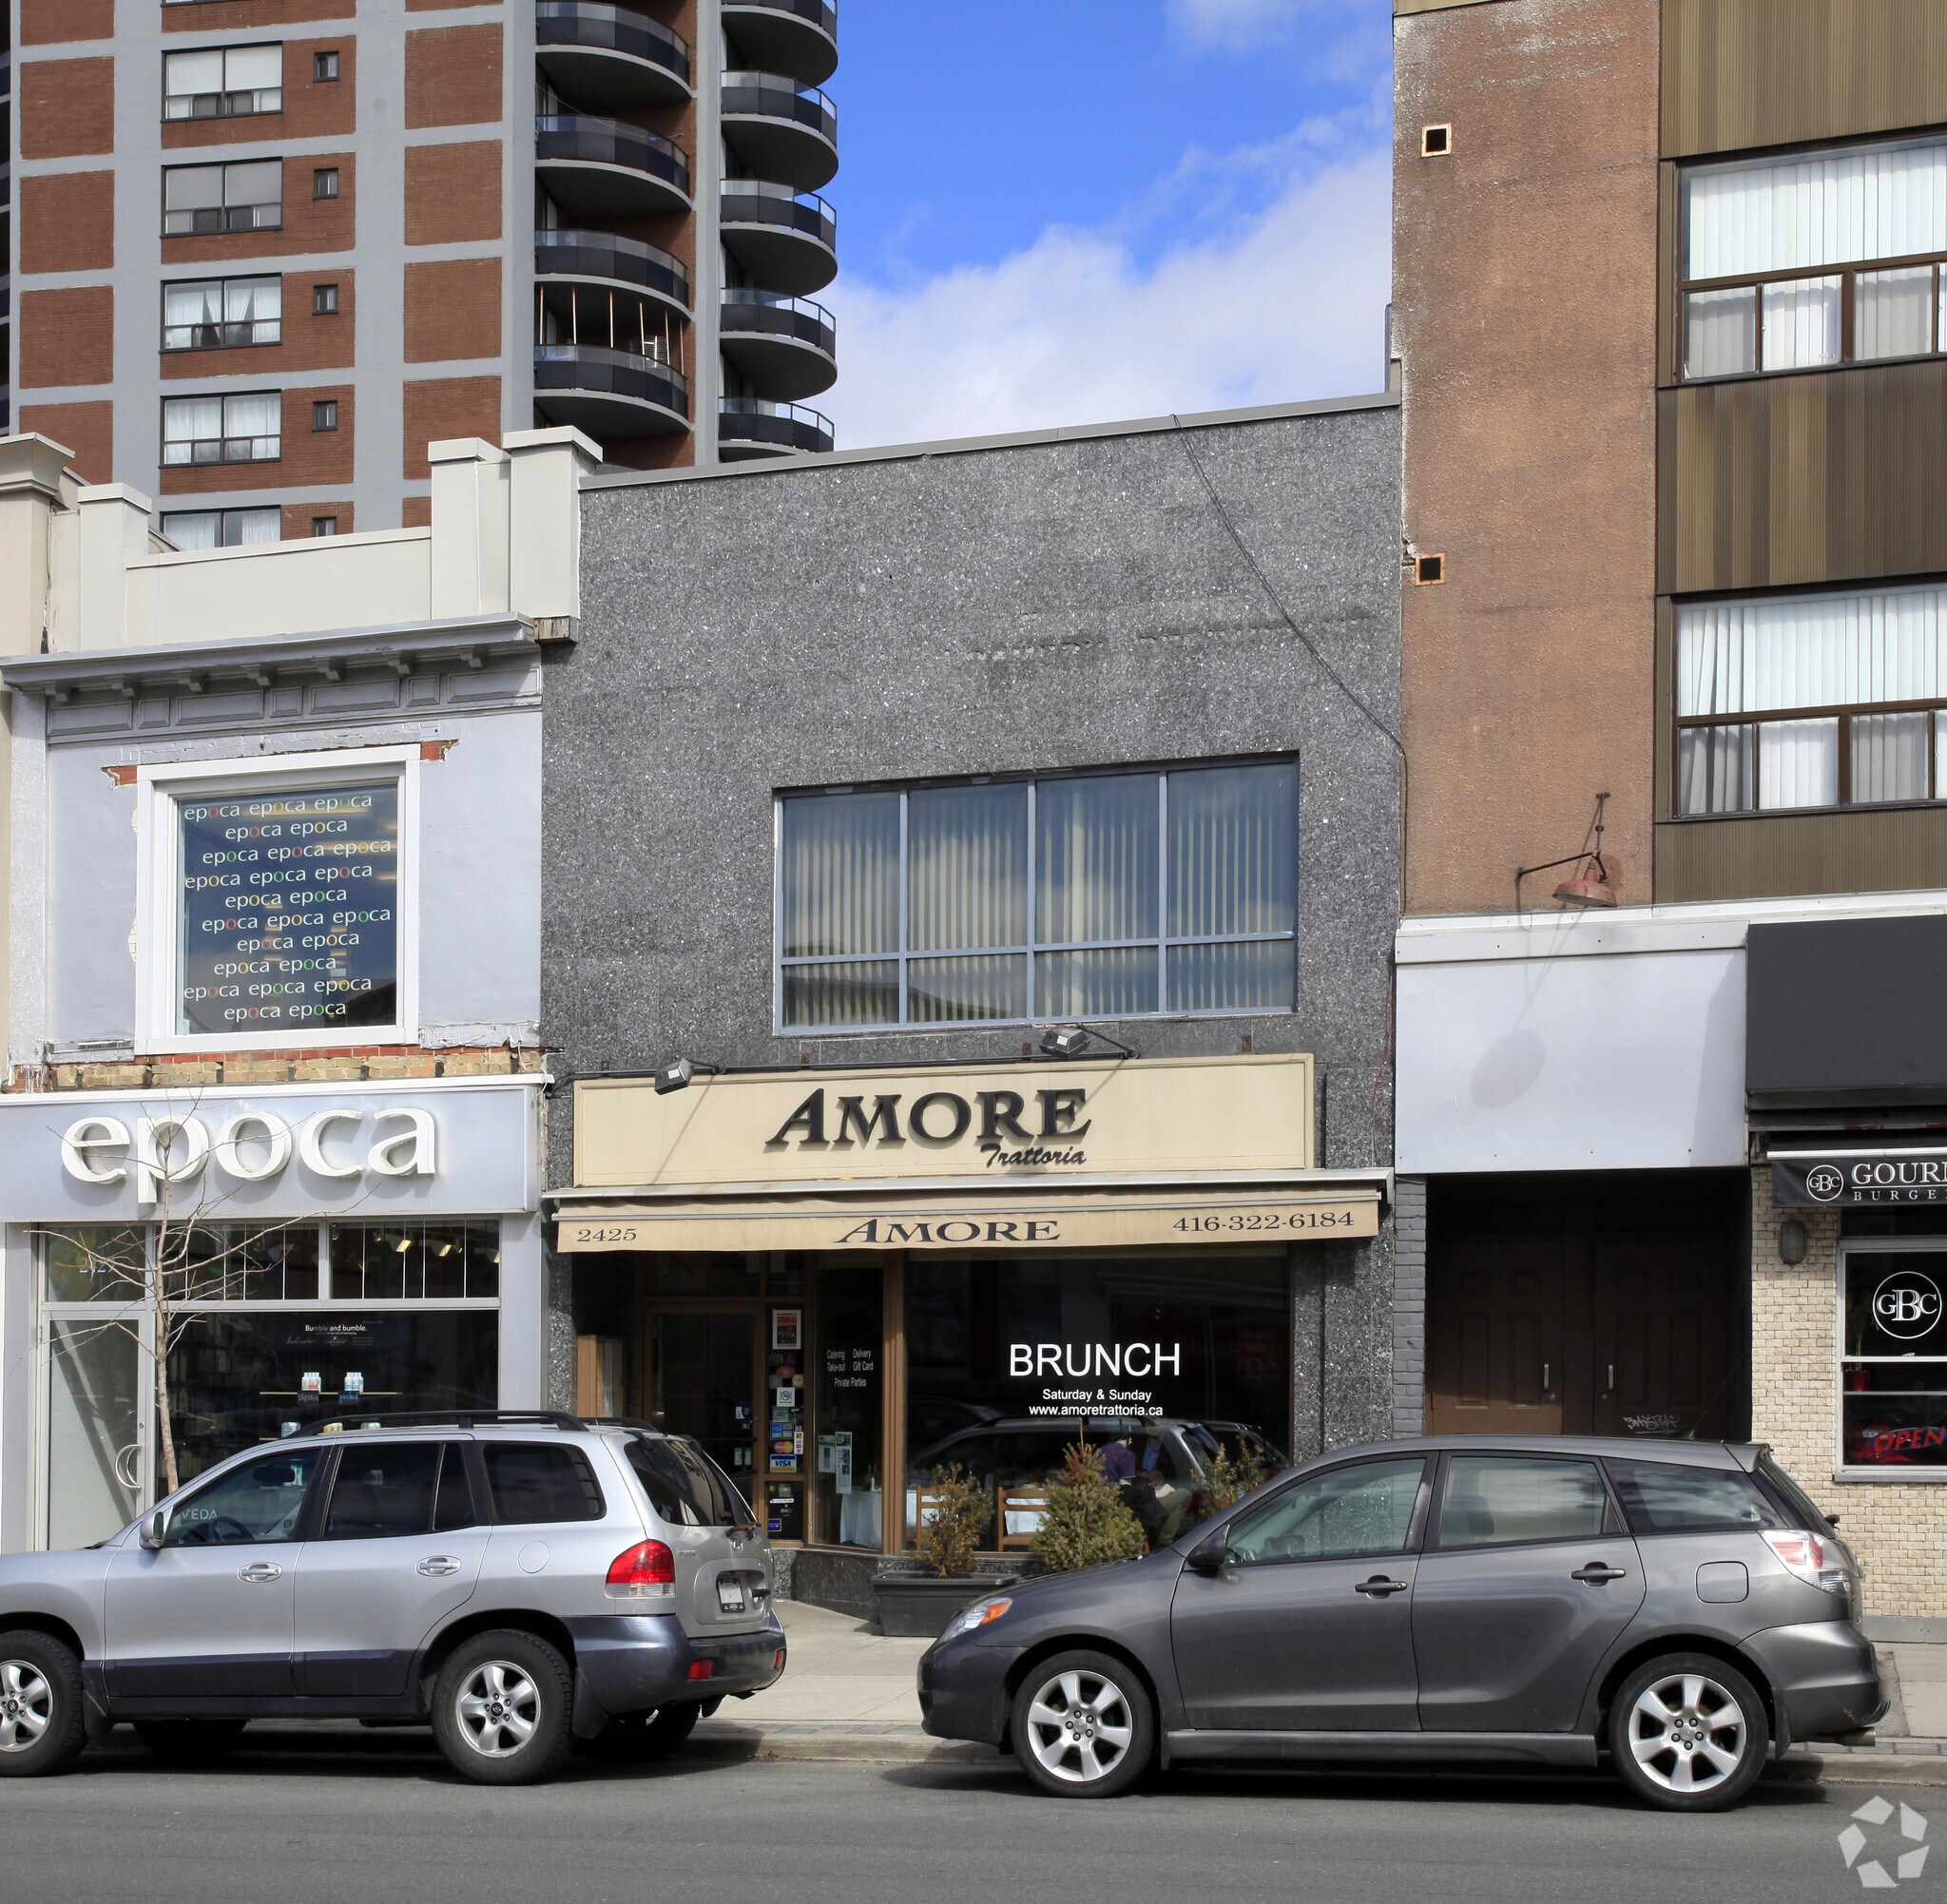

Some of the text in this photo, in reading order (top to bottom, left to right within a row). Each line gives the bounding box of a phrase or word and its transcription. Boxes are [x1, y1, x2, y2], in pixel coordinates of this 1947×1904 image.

[184, 796, 372, 822] epoca epoca epoca
[225, 820, 347, 841] epoca epoca
[202, 840, 391, 866] epoca epoca epoca
[185, 865, 372, 891] epoca epoca epoca
[225, 890, 347, 910] epoca epoca
[202, 909, 390, 933] epoca epoca epoca
[238, 933, 359, 953] epoca epoca
[214, 958, 336, 977] epoca epoca
[183, 978, 372, 1001] epoca epoca epoca
[224, 1003, 346, 1022] epoca epoca
[764, 1088, 1092, 1145] AMORE
[61, 1106, 435, 1203] epoca
[980, 1143, 1087, 1167] Trattoria
[1854, 1189, 1947, 1202] BURGE
[834, 1218, 1061, 1244] AMORE
[1172, 1211, 1354, 1232] 416-322-6184
[576, 1228, 637, 1242] 2425
[1877, 1289, 1937, 1321] GBC
[827, 1350, 845, 1360] Catering
[853, 1349, 872, 1359] Delivery
[1010, 1343, 1180, 1376] BRUNCH
[826, 1362, 846, 1372] Take-out
[853, 1360, 874, 1372] Gift Card
[835, 1376, 867, 1387] Private Parties
[1042, 1388, 1152, 1403] Saturday & Sunday
[1029, 1404, 1163, 1416] www.amoretrattoria.ca
[1874, 1426, 1947, 1452] OPEN
